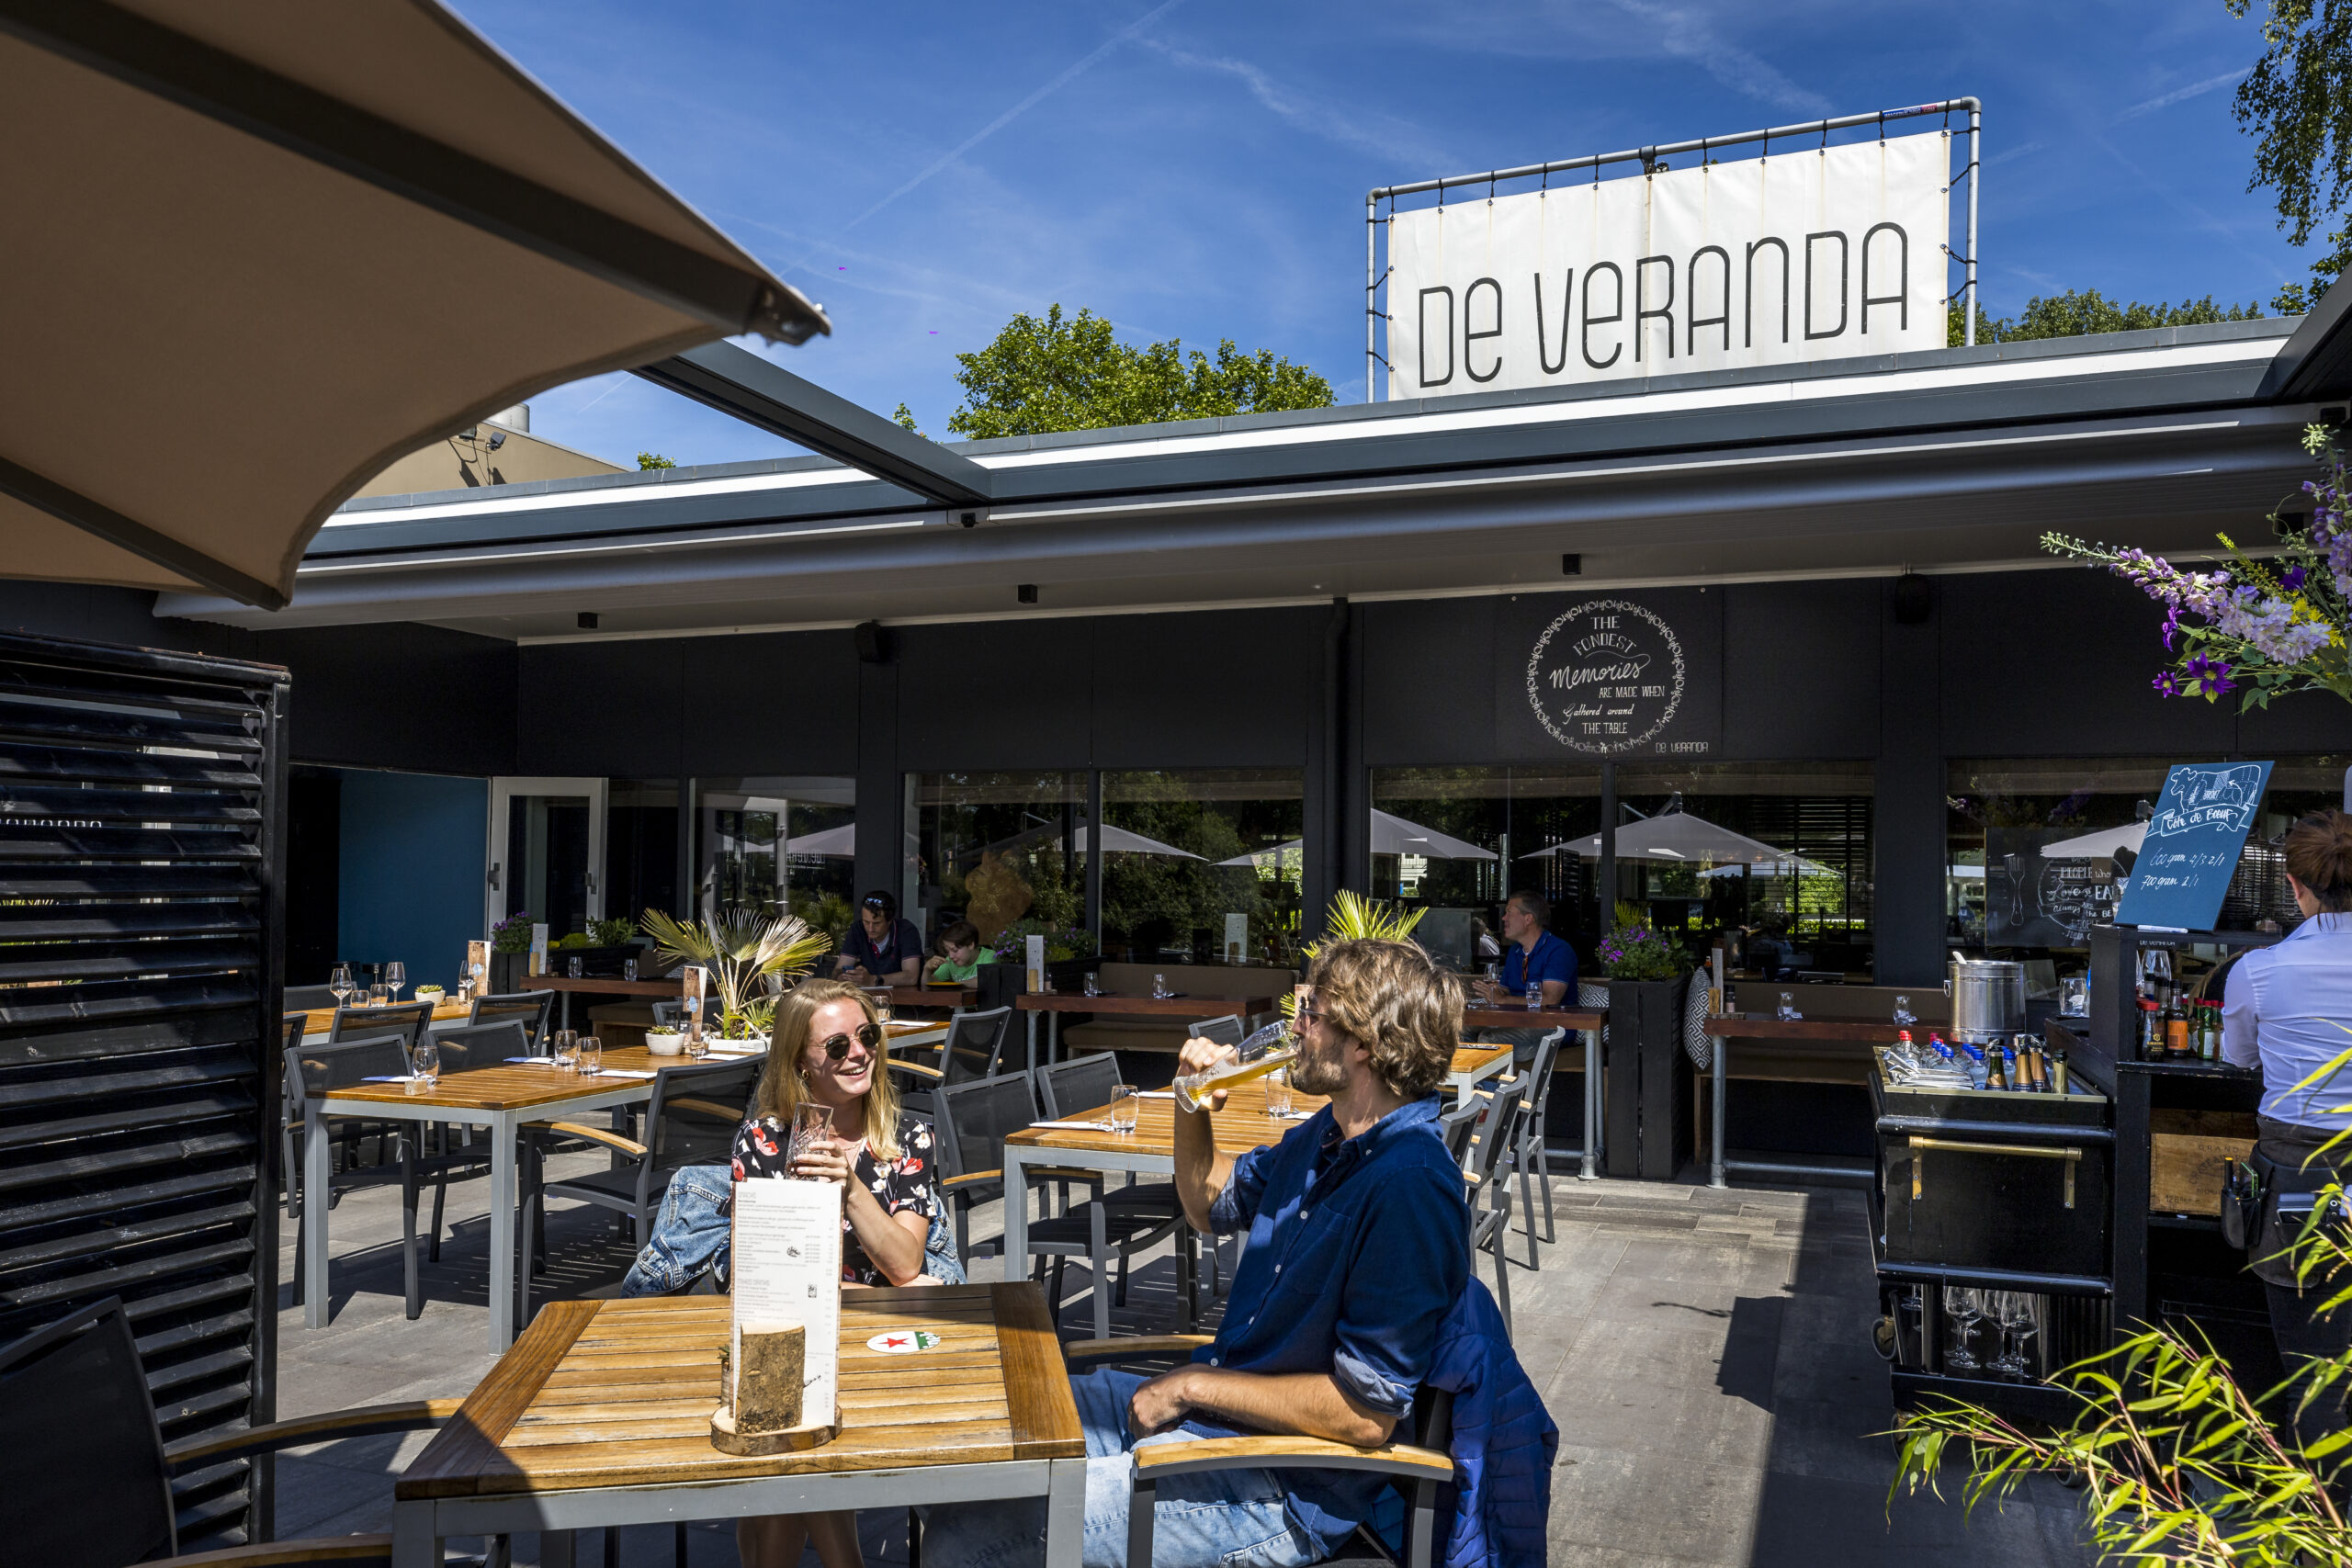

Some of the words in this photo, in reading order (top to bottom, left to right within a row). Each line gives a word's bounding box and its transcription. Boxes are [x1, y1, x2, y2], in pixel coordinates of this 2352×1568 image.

[1590, 615, 1621, 630] THE
[1572, 632, 1637, 657] FONDEST
[1549, 660, 1643, 691] Memories
[1598, 687, 1612, 699] ARE
[1615, 686, 1638, 698] MADE
[1642, 685, 1666, 697] WHEN
[1562, 704, 1600, 725] Gathered
[1607, 704, 1635, 716] around
[1581, 722, 1601, 735] THE
[1603, 722, 1628, 735] TABLE
[2060, 867, 2092, 879] PEOPLE
[2095, 885, 2113, 900] EA
[2198, 1144, 2240, 1154] GRAND
